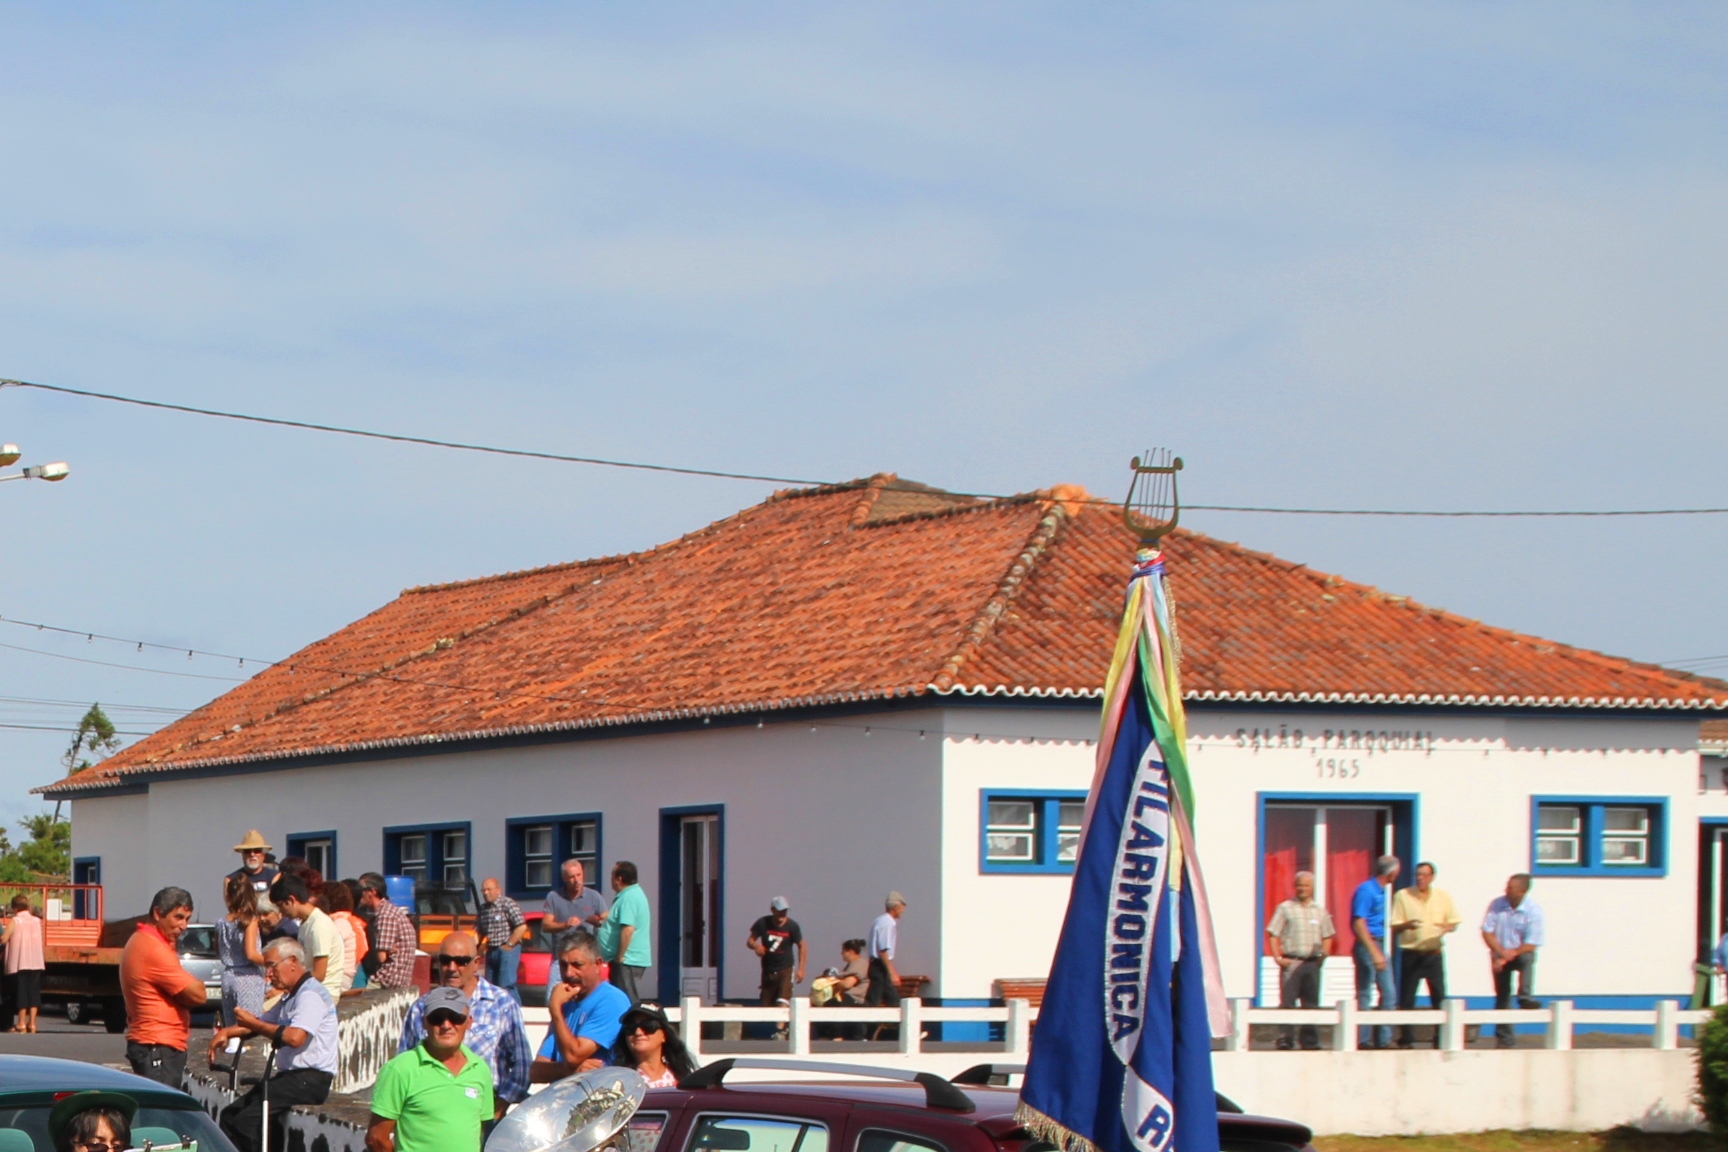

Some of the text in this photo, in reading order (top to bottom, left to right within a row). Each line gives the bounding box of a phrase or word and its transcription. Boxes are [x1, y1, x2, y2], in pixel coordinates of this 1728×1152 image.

[1235, 723, 1304, 749] SALÃO
[1315, 757, 1361, 779] 1965
[768, 934, 783, 952] 7
